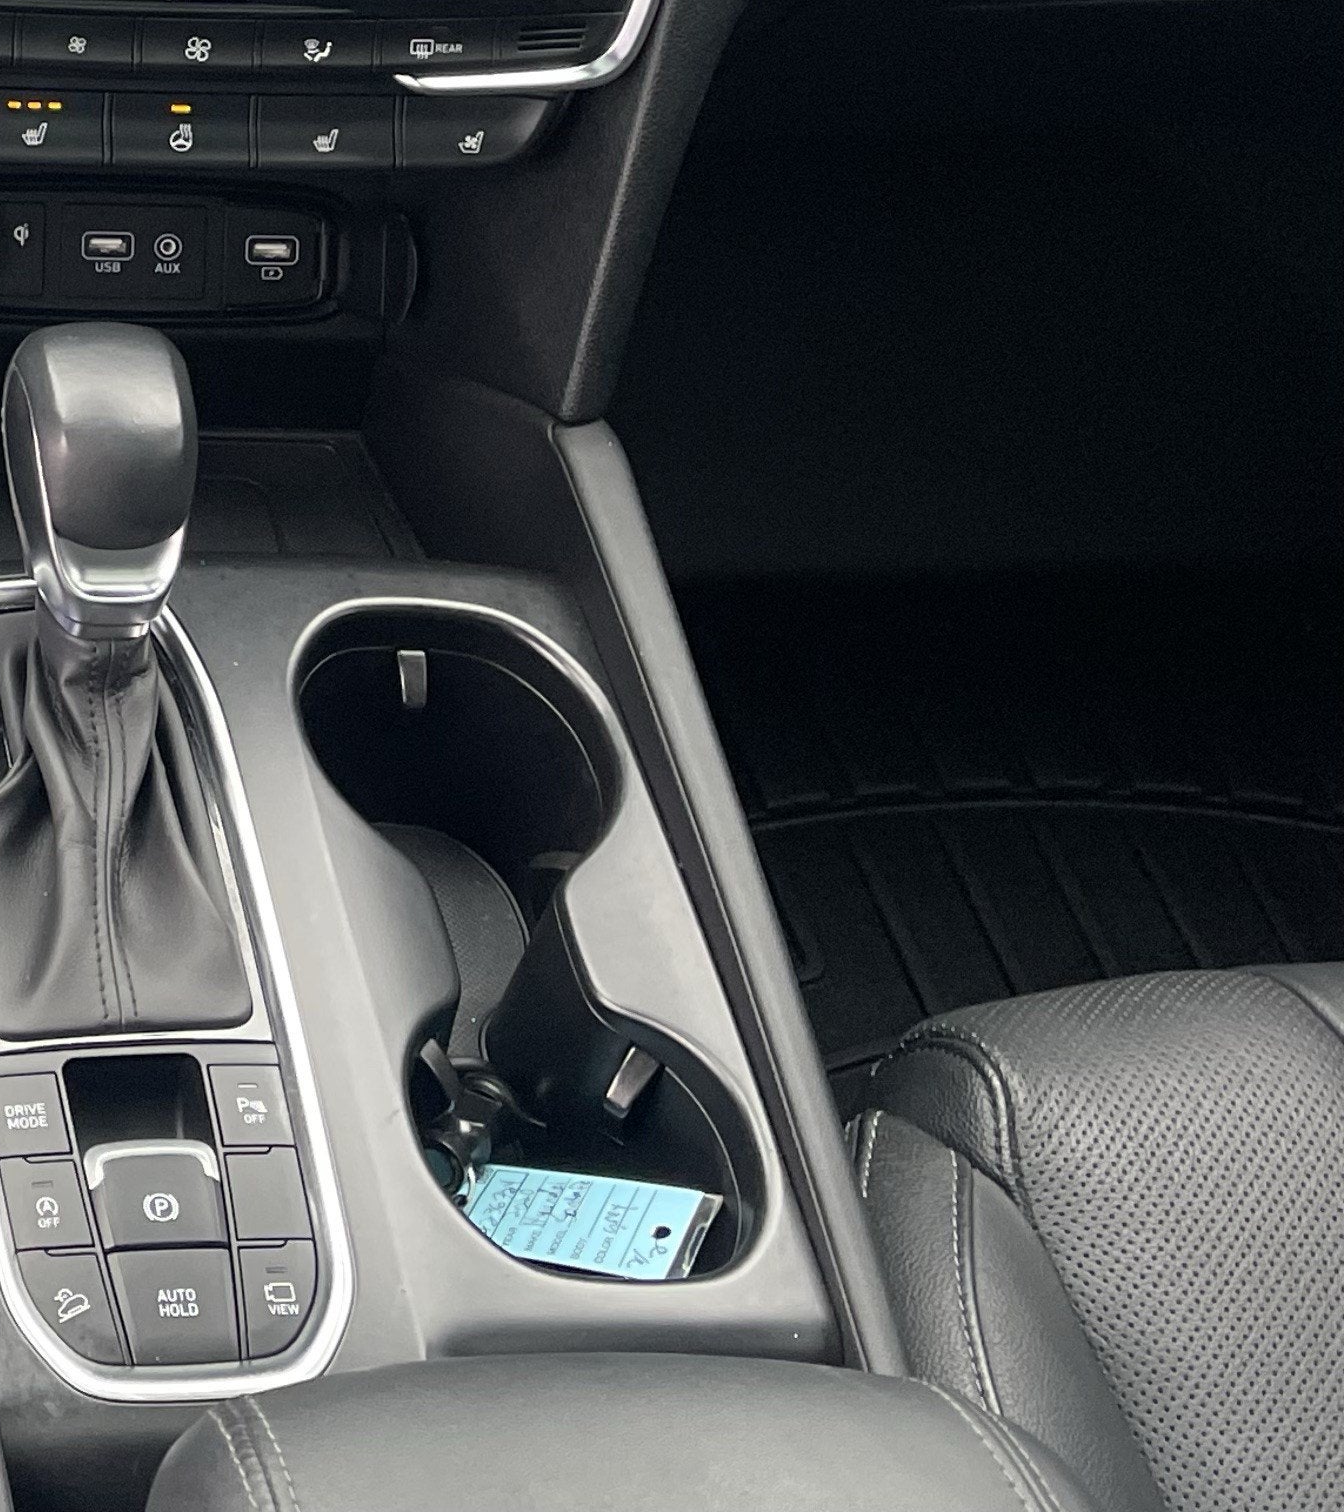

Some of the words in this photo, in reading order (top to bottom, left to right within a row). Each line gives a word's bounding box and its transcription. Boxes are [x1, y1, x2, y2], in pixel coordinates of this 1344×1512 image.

[435, 43, 463, 54] REAR
[94, 261, 121, 274] USB
[154, 261, 181, 274] AUX
[4, 1103, 46, 1118] DRIVE
[7, 1116, 48, 1130] MODE
[244, 1113, 265, 1124] OFF
[37, 1217, 60, 1229] OFF
[157, 1289, 197, 1302] AUTO
[159, 1303, 199, 1317] HOLD
[267, 1304, 300, 1316] VIEW
